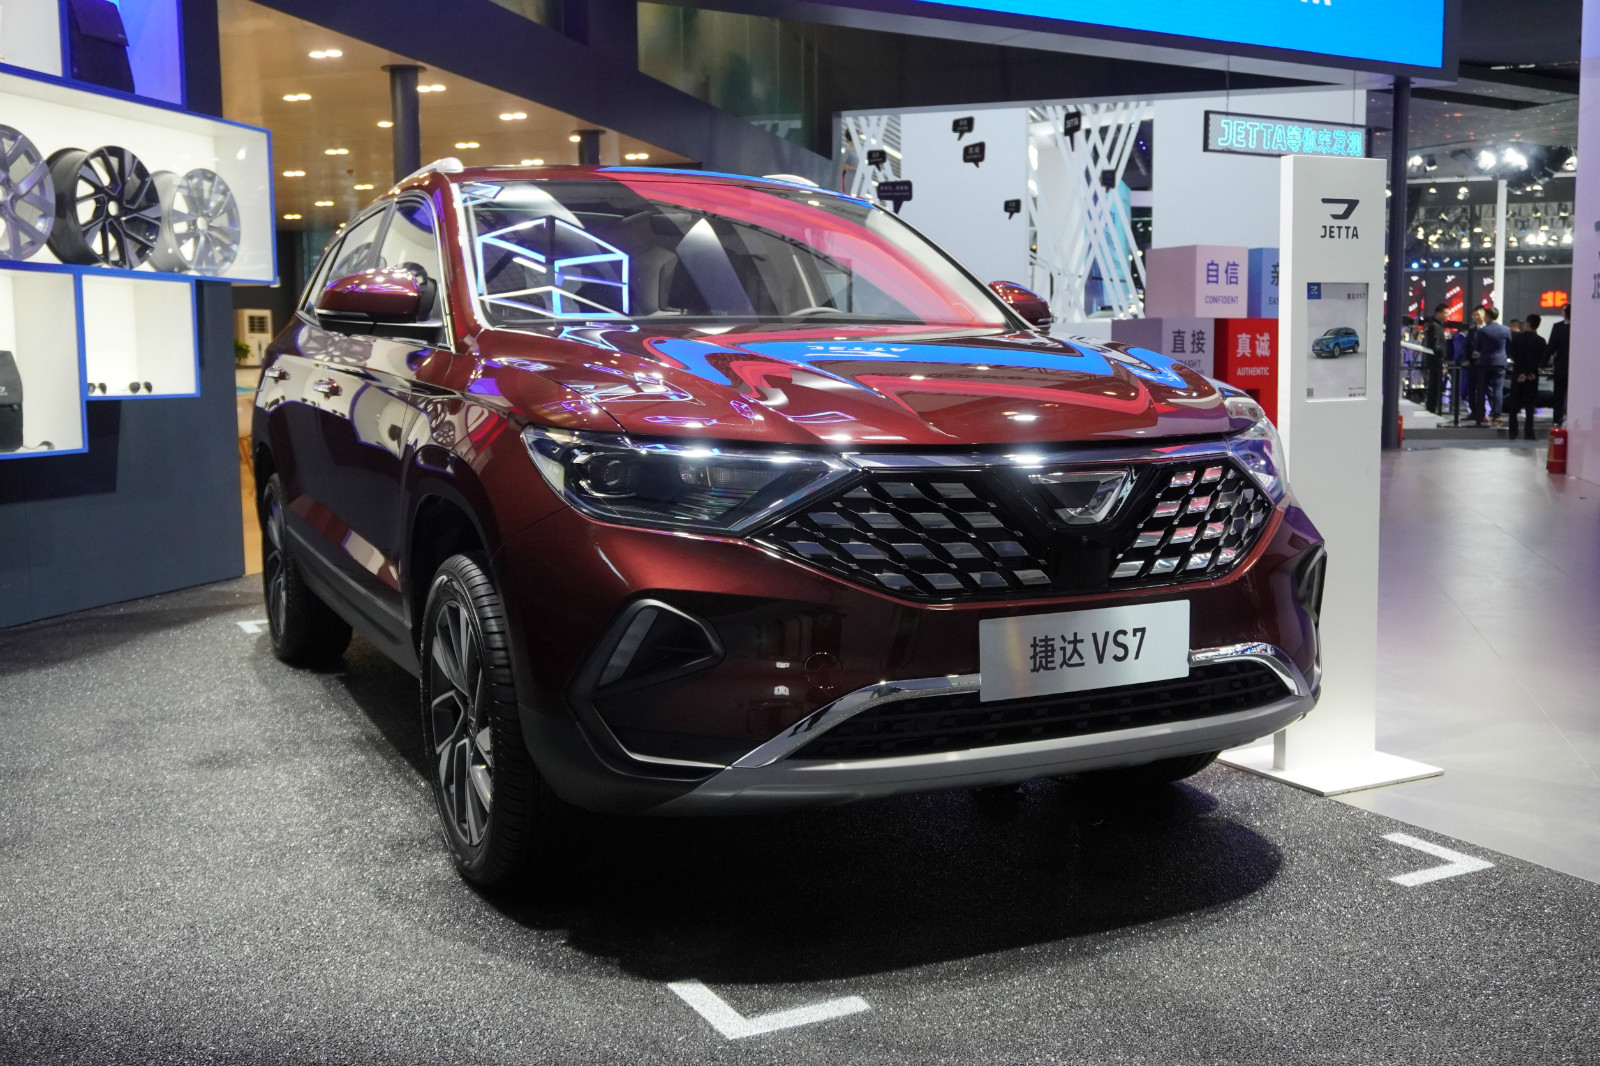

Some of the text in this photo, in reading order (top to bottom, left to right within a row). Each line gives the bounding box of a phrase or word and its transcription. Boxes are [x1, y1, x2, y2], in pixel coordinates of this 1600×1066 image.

[1218, 119, 1362, 157] JETTA等你来发现
[1320, 225, 1359, 239] JETTA
[1206, 260, 1239, 286] 自信
[1205, 295, 1239, 305] CONFIDENT
[1171, 329, 1206, 354] 直接
[1236, 332, 1271, 358] 真诚
[1237, 366, 1270, 376] AUTHENTIC
[1030, 627, 1147, 673] 捷达 VS7
